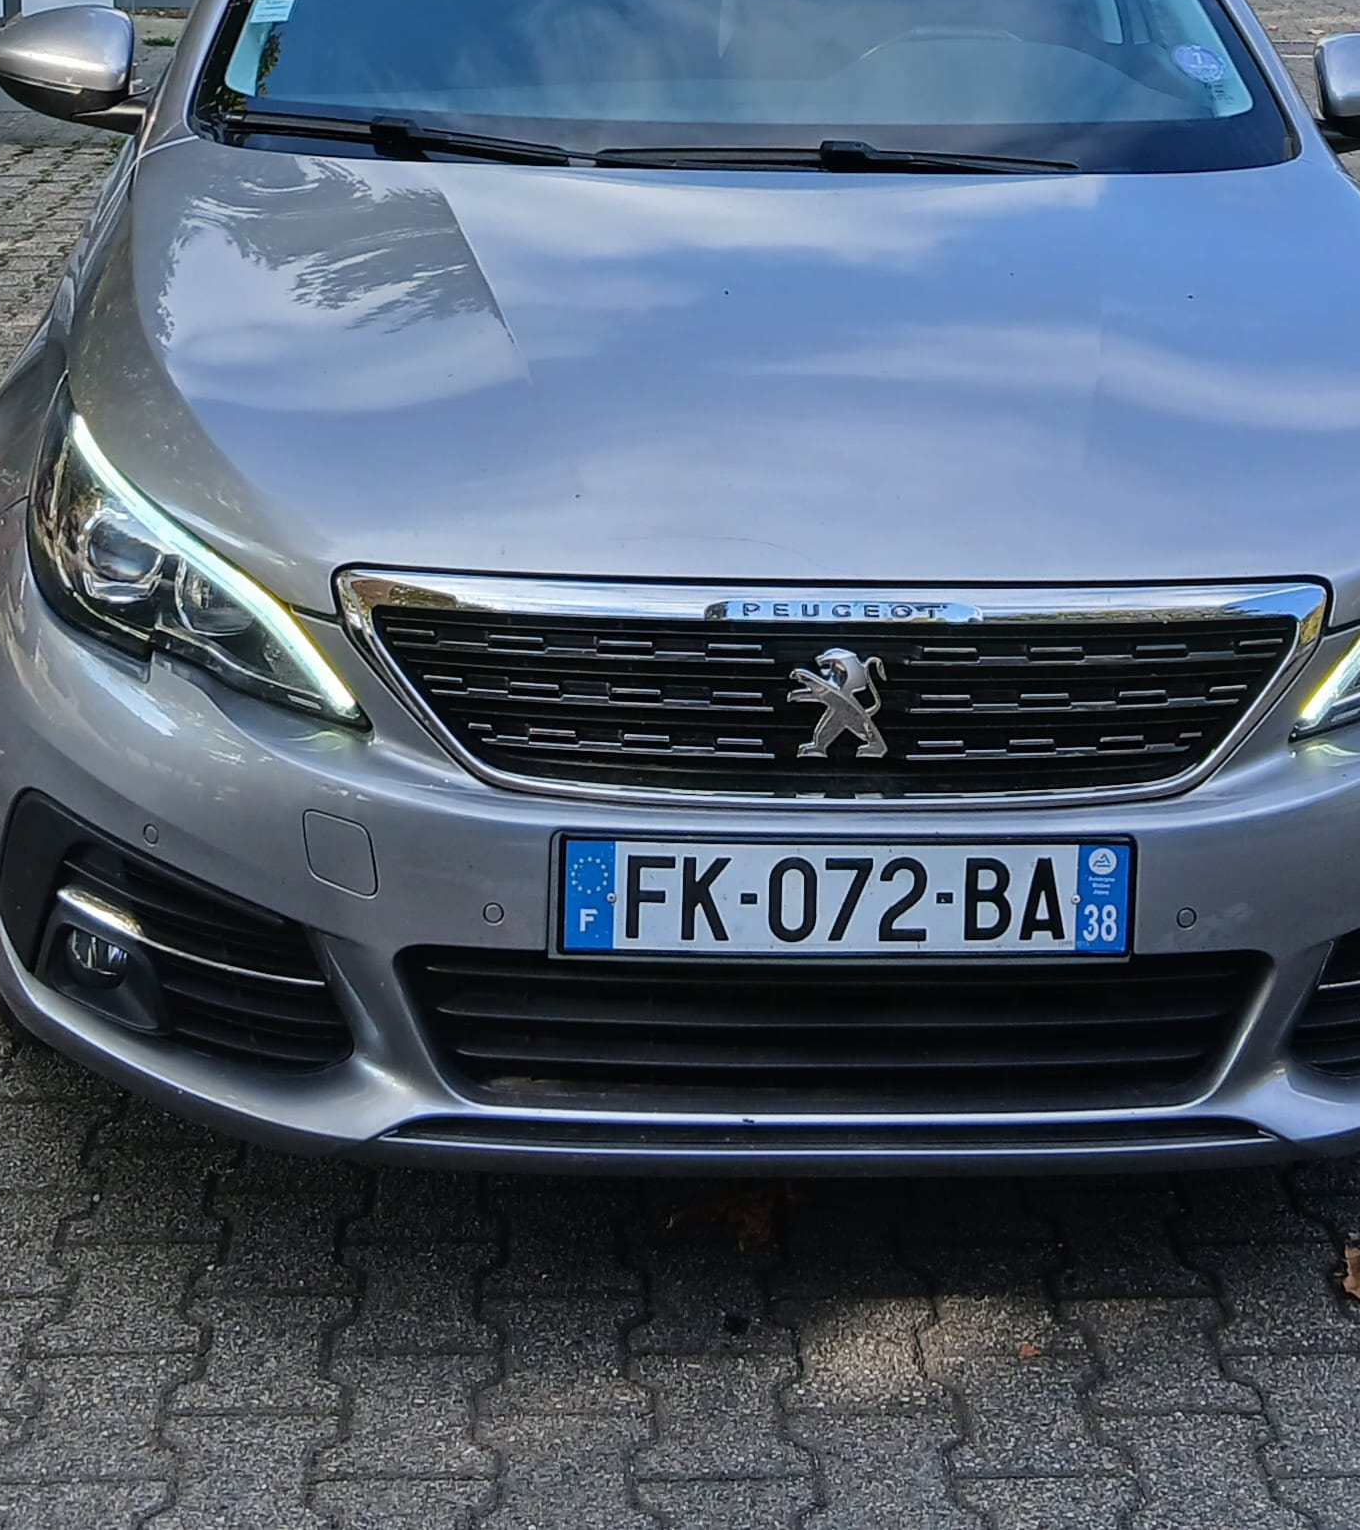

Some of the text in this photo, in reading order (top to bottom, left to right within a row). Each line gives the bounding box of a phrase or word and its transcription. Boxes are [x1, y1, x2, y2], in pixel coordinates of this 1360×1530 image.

[742, 602, 947, 619] PEUGEOT
[579, 854, 1118, 943] F FK-072-BA 38
